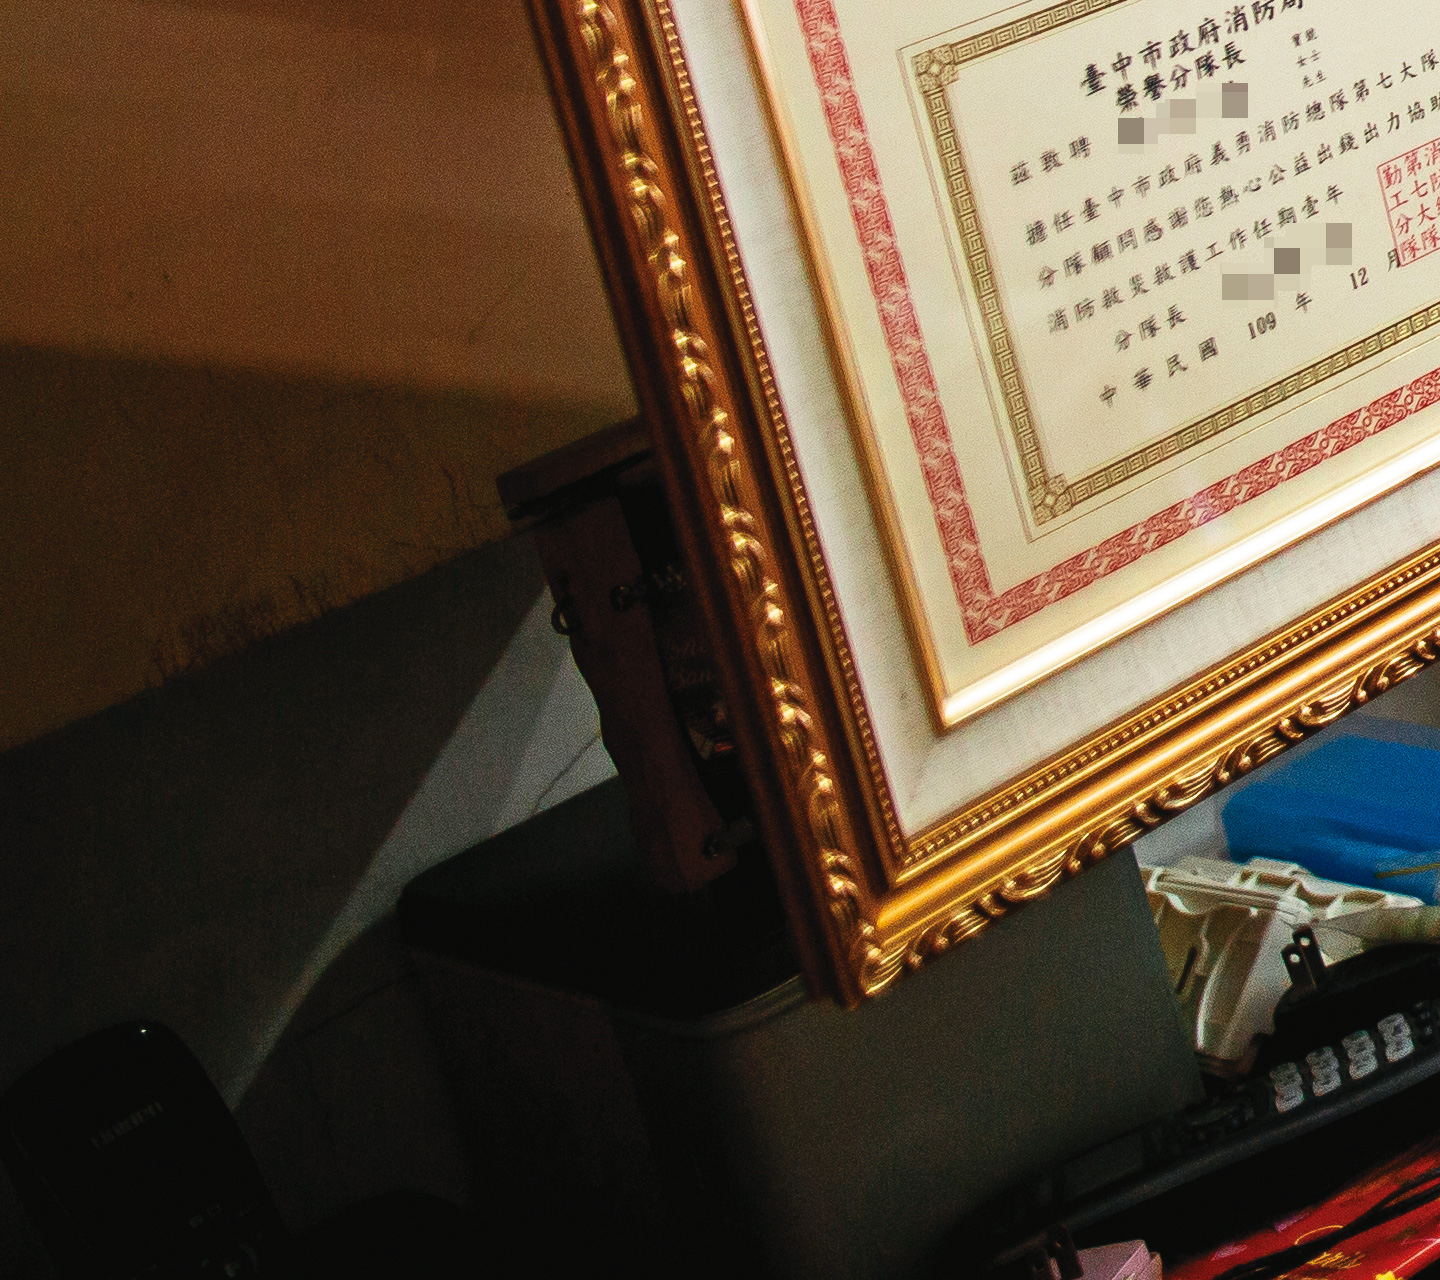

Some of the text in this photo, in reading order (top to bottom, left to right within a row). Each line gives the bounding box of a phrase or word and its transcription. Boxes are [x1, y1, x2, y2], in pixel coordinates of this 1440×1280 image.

[1115, 41, 1247, 114] 榮譽分隊長
[1010, 136, 1092, 186] 茲敦聘
[1099, 337, 1219, 408] 中華民國
[1247, 311, 1277, 340] 109
[1294, 291, 1313, 314] 年
[1349, 267, 1370, 290] 12
[1114, 304, 1188, 353] 分隊長
